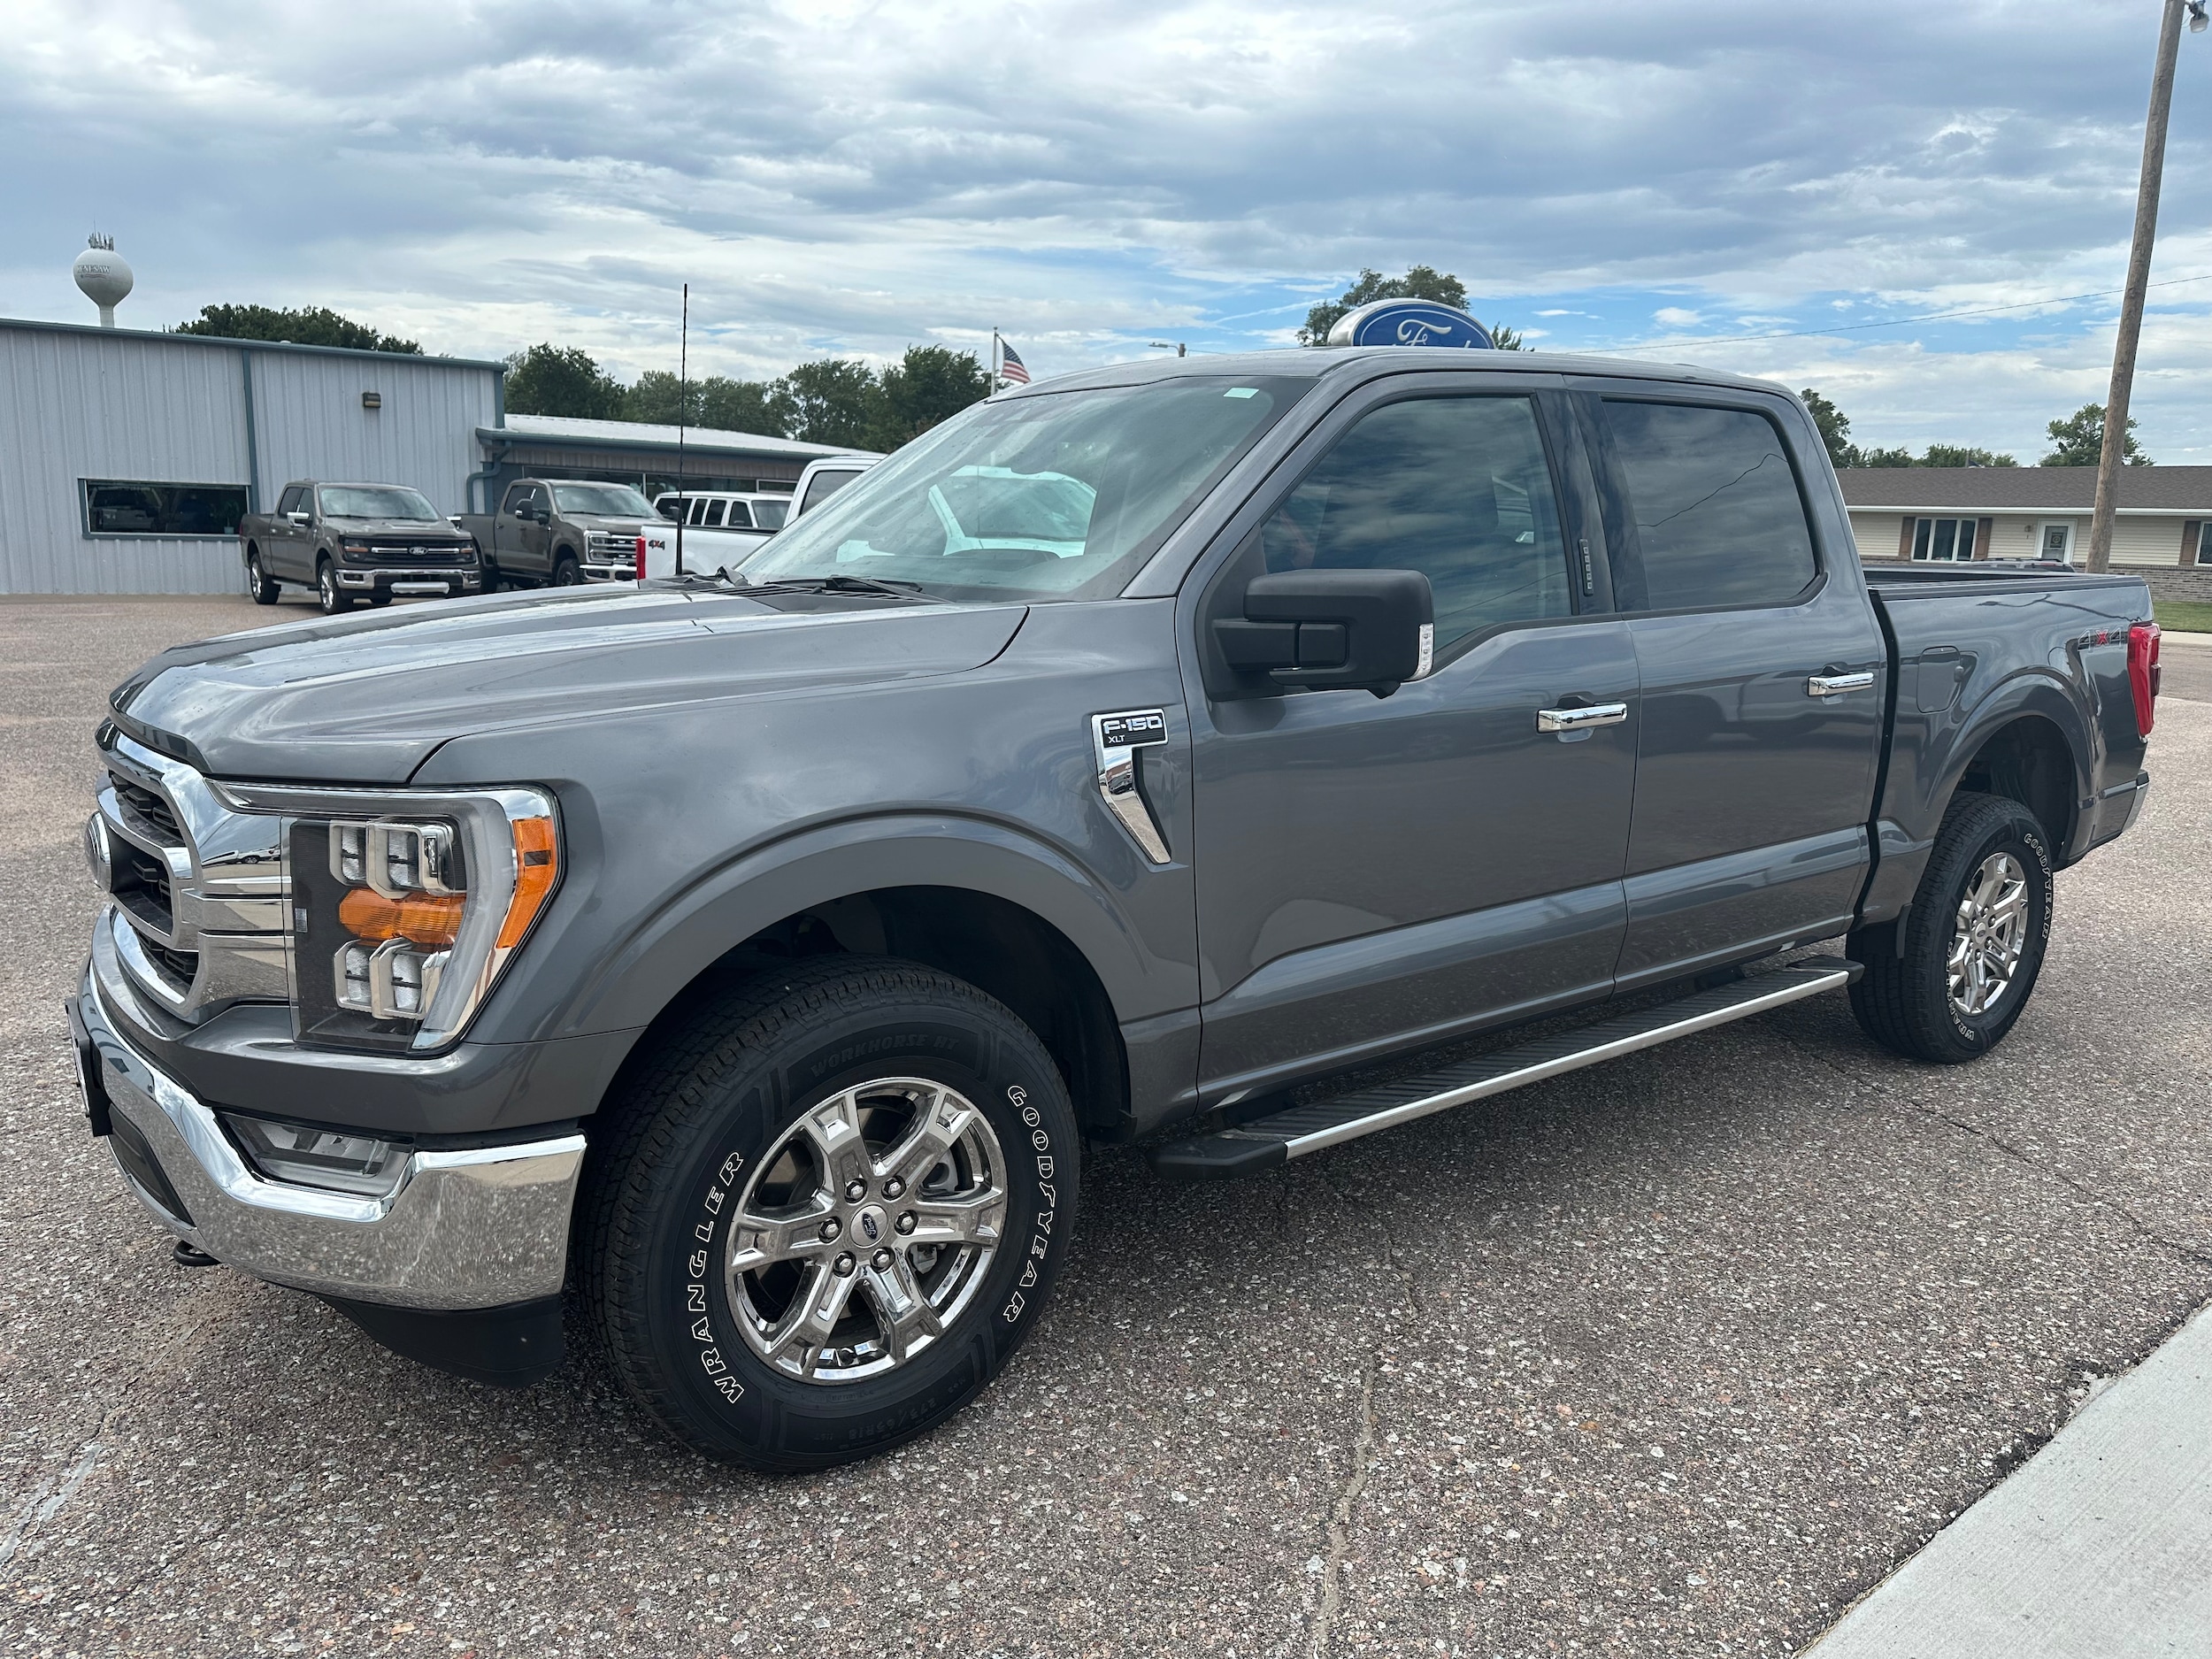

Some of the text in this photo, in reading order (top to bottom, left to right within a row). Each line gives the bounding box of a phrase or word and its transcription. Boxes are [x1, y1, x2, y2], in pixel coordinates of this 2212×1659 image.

[1103, 715, 1163, 733] F-150
[1108, 734, 1125, 744] XLT
[2024, 833, 2053, 939] GOODYEAR
[810, 1033, 960, 1078] WORKHORSE HT
[1002, 1085, 1056, 1323] GOODYEAR
[687, 1151, 745, 1404] WRANGLER
